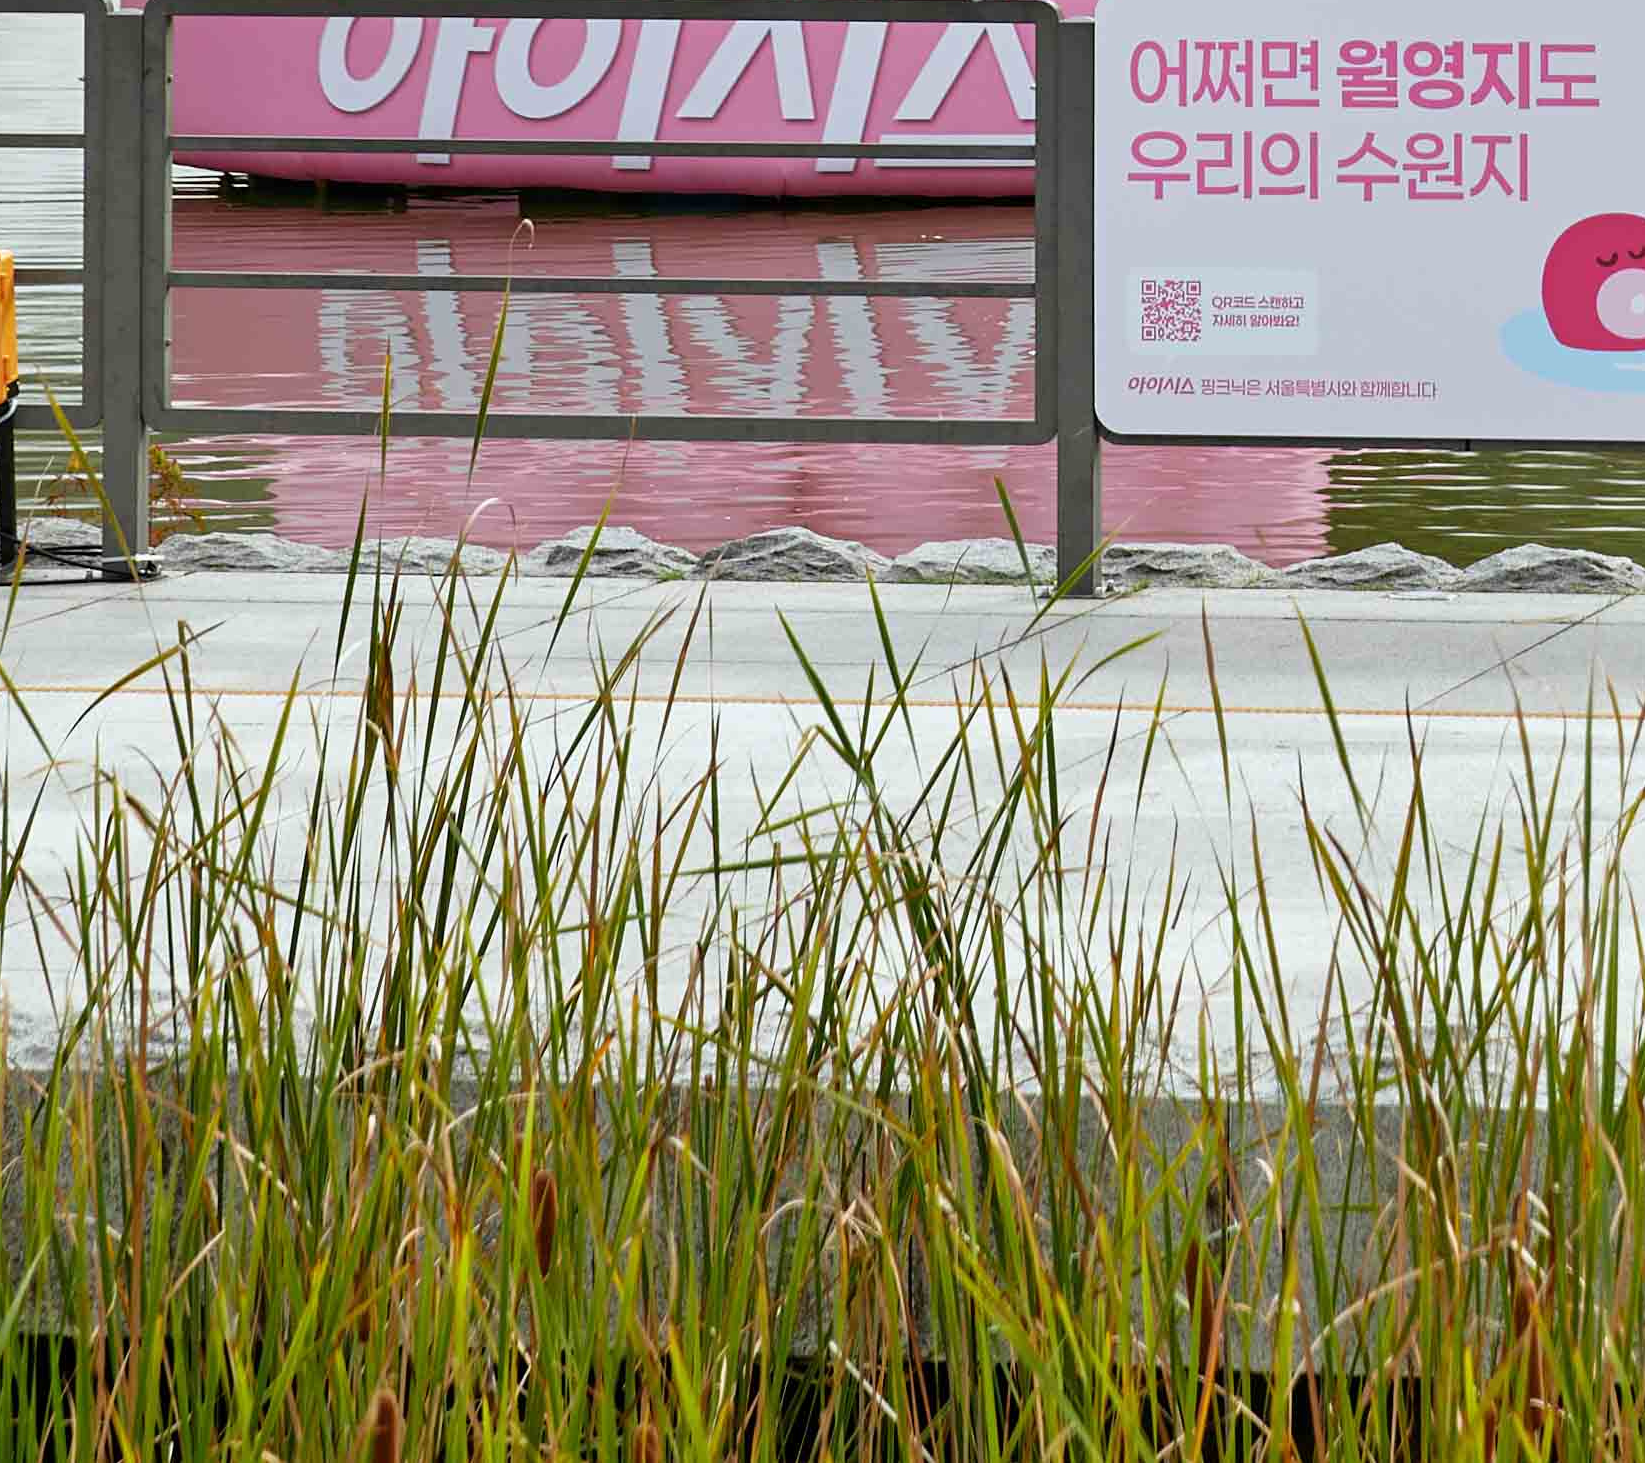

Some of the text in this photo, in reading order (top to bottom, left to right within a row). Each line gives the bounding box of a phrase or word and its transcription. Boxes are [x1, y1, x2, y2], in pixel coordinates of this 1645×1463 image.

[1129, 38, 1601, 110] 어쩌면 월영지도
[1127, 130, 1529, 203] 우리의 수원지
[1212, 295, 1305, 310] QR코드 스캔하고
[1212, 313, 1300, 328] 자세히 알아봐요!
[1127, 376, 1437, 398] 아이시스 핑크닉은 서울특별시와 함께합니다
